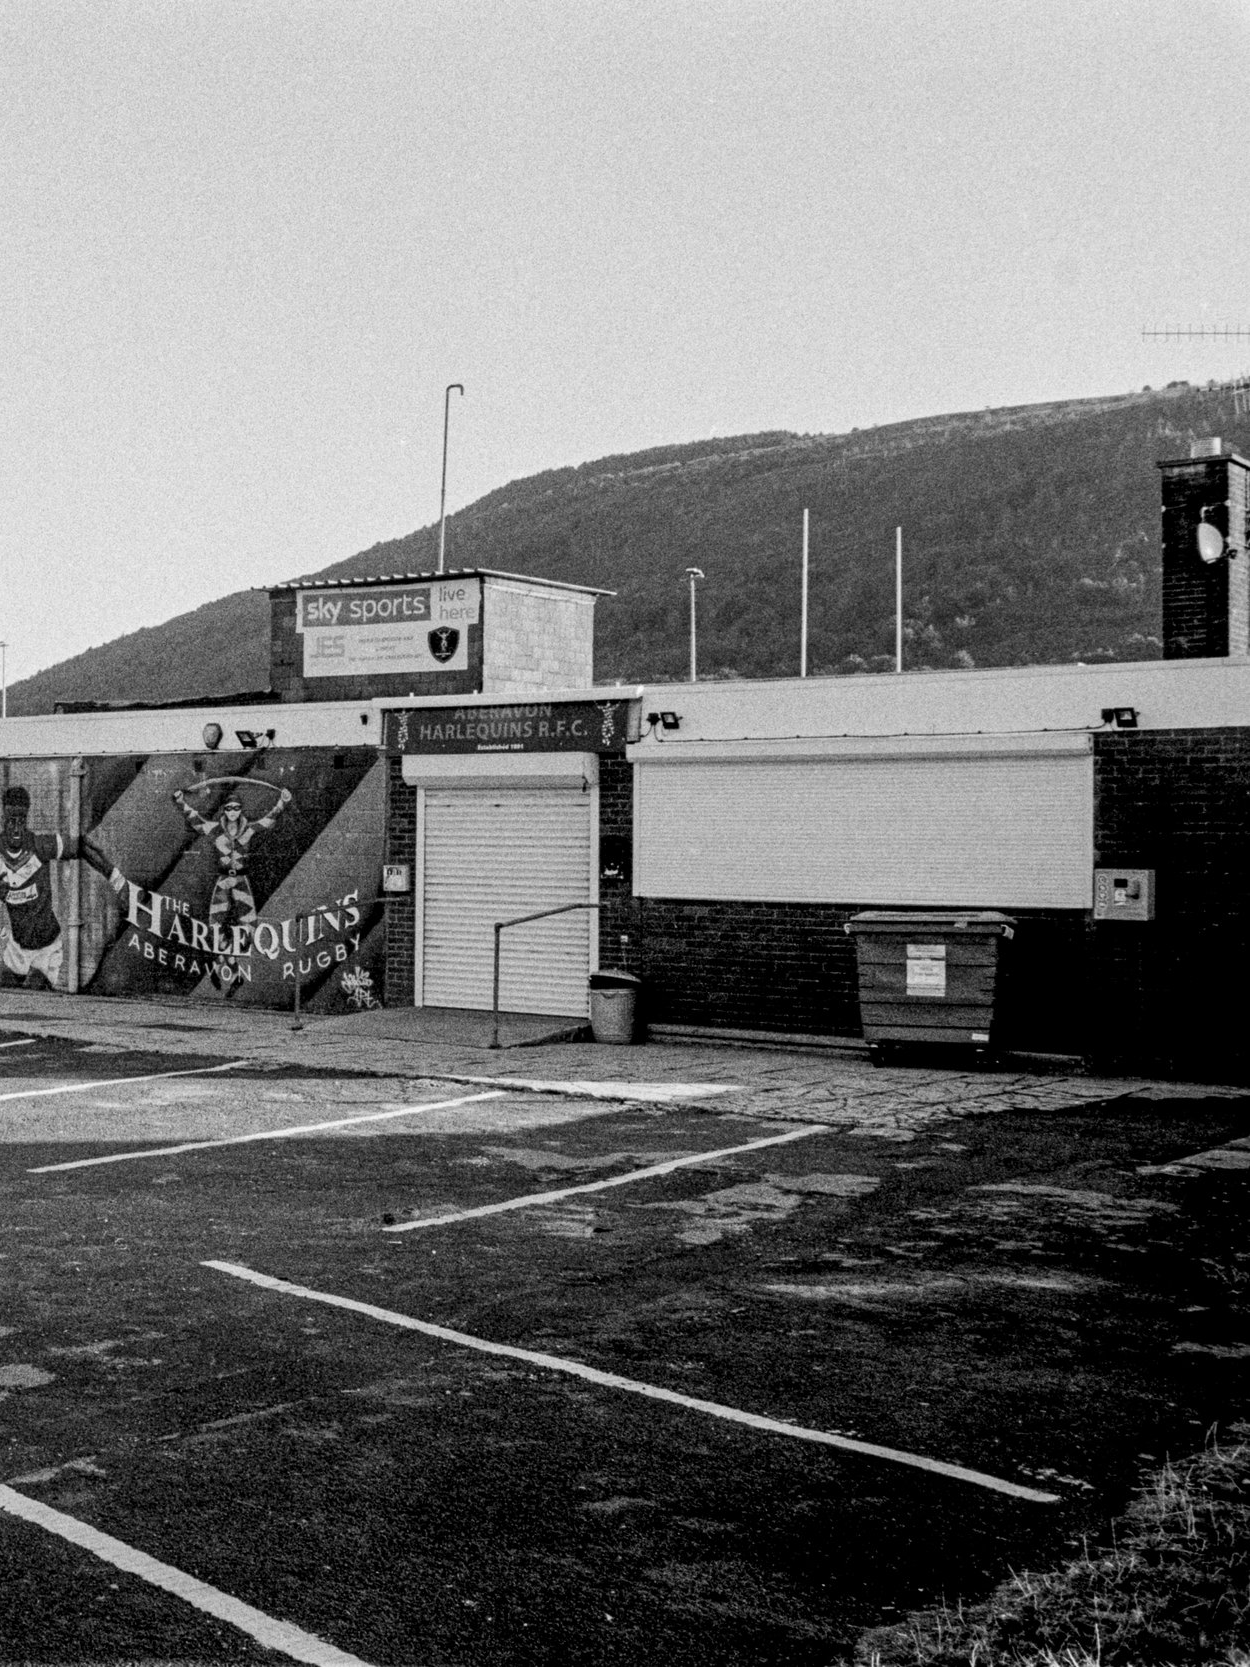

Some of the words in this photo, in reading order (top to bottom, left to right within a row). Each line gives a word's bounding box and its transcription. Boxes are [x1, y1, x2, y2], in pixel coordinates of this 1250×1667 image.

[439, 586, 466, 602] live
[307, 597, 342, 624] sky
[350, 594, 425, 622] sports
[439, 604, 476, 620] here
[419, 721, 533, 741] HARLEQUINS
[538, 719, 588, 738] R.F.C.
[162, 894, 191, 918] THE
[125, 879, 361, 960] HARLEQUINS
[128, 932, 252, 983] ABERAVON
[282, 932, 361, 980] RUGBY
